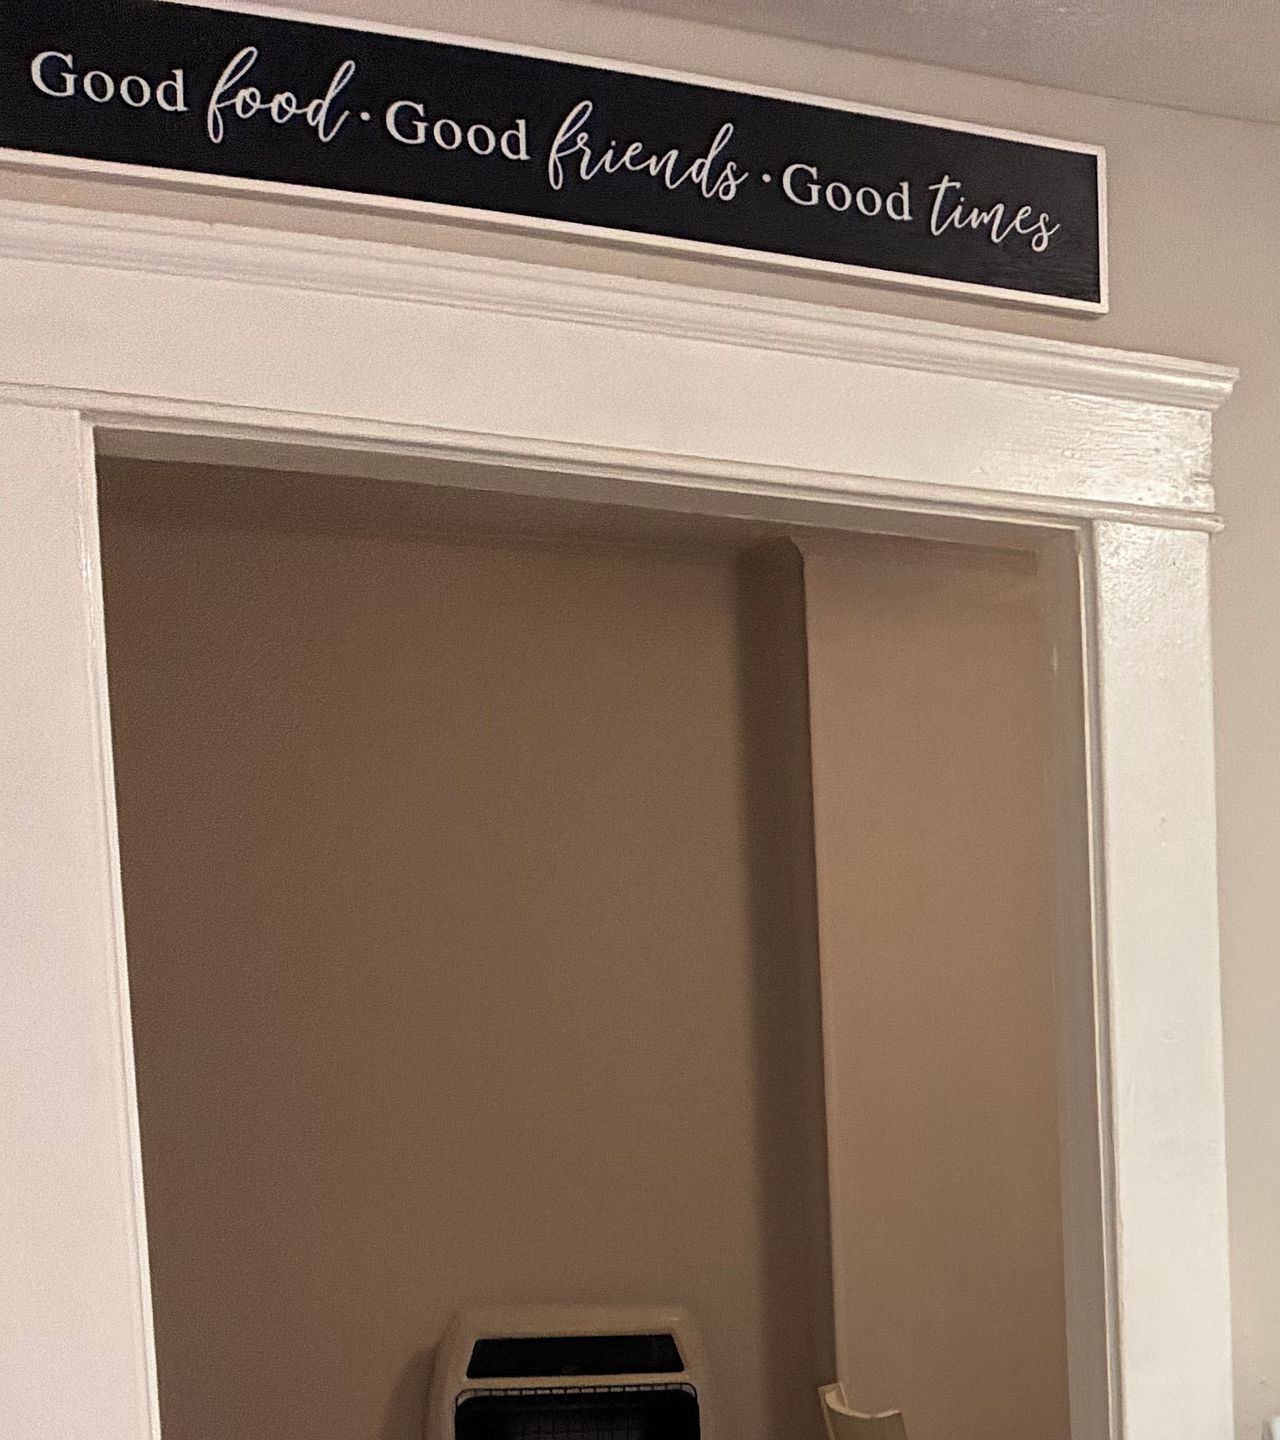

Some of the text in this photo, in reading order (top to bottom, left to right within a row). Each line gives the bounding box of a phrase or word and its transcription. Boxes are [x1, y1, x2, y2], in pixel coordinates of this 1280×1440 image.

[31, 46, 1061, 253] Good food Good friends Good times
